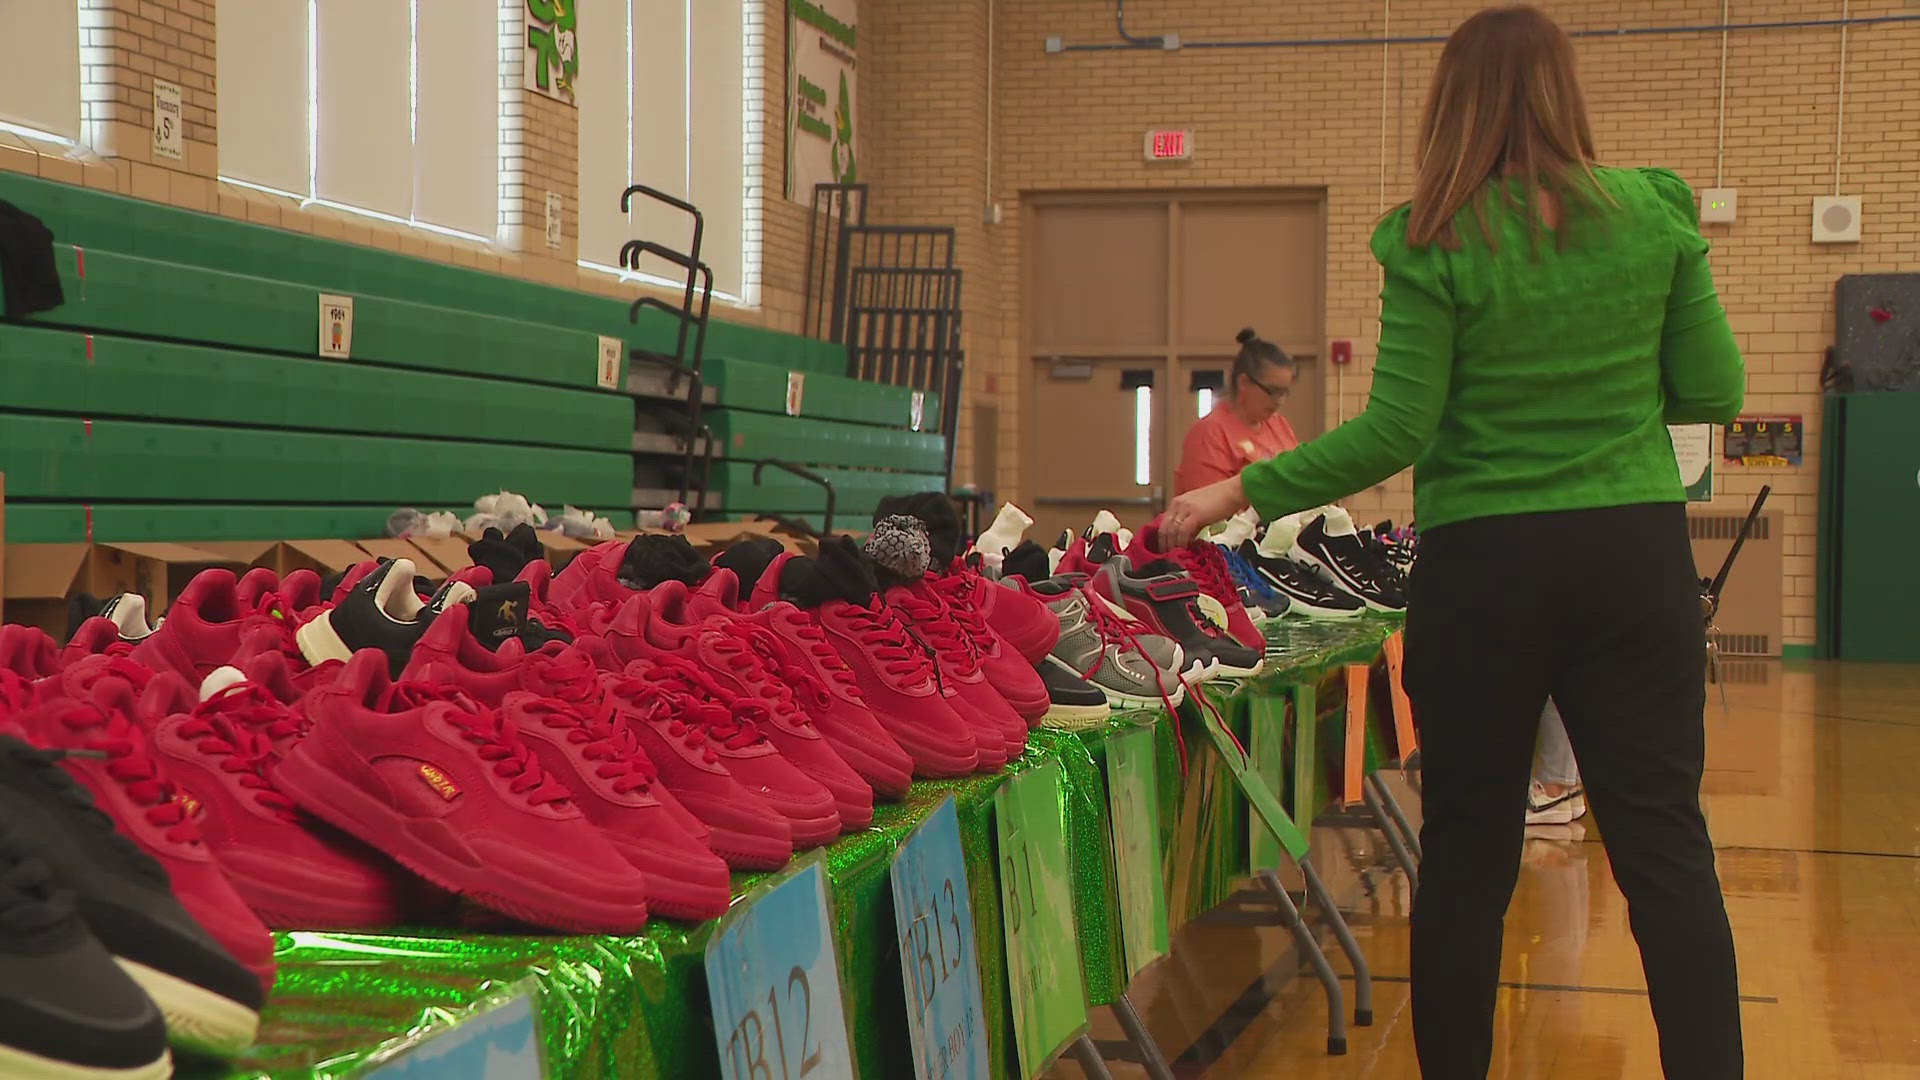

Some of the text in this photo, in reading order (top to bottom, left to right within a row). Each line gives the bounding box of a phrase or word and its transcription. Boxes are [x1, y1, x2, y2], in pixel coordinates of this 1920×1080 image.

[1153, 131, 1184, 157] EXIT
[903, 878, 961, 1027] TB13
[726, 964, 823, 1080] TB12
